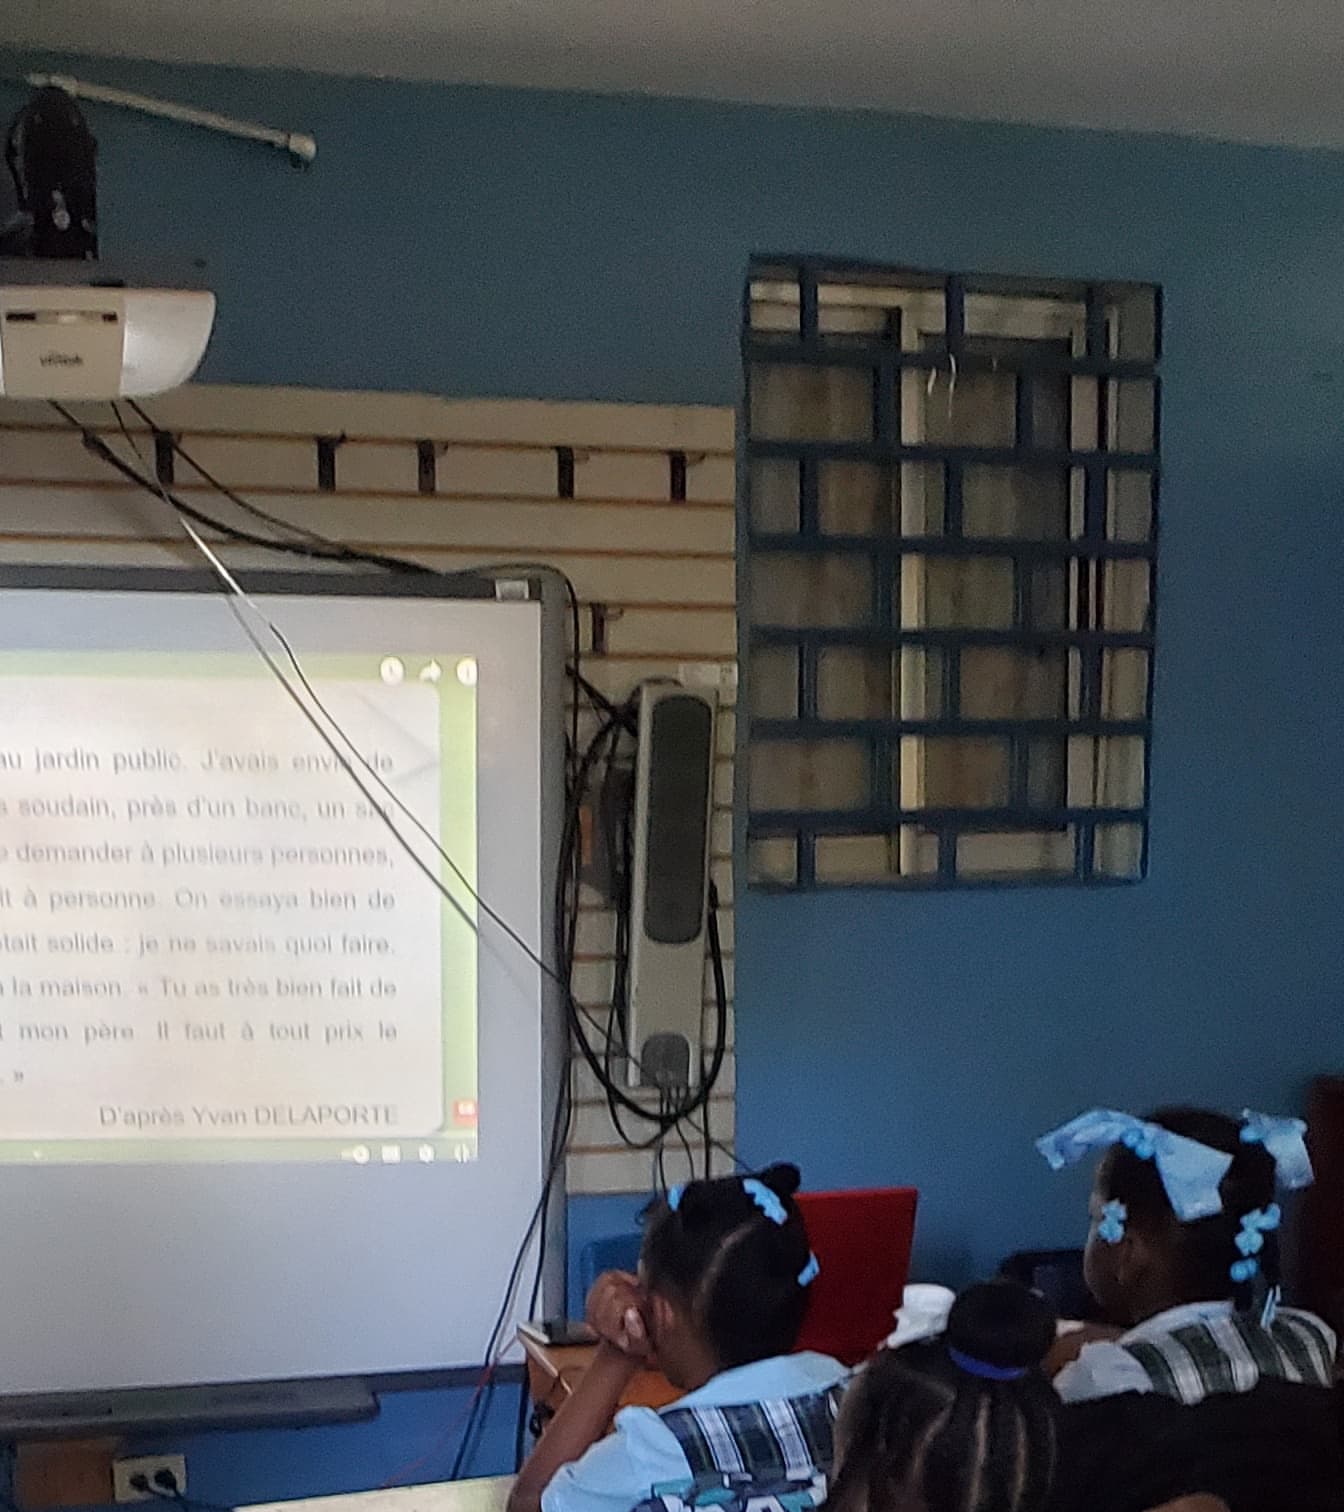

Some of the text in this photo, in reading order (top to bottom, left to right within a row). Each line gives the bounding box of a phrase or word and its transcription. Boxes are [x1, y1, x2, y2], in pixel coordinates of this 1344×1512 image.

[35, 747, 100, 775] jardin
[200, 748, 280, 770] J'avais
[18, 795, 117, 821] soudain,
[127, 796, 177, 823] près
[187, 795, 236, 818] d'un
[317, 801, 345, 818] un
[15, 841, 133, 864] demander
[140, 841, 155, 864] à
[162, 842, 263, 868] plusieurs
[24, 887, 38, 907] à
[175, 888, 207, 908] On
[218, 891, 298, 914] essaya
[309, 887, 357, 909] bien
[367, 887, 396, 909] de
[47, 932, 114, 953] solide
[139, 933, 158, 958] je
[170, 936, 197, 954] ne
[206, 934, 276, 954] savais
[285, 933, 332, 959] quoi
[12, 977, 32, 998] la
[160, 977, 187, 998] Tu
[194, 982, 221, 999] as
[228, 978, 269, 999] très
[276, 978, 323, 1000] bien
[330, 977, 362, 1000] fait
[370, 978, 398, 1000] de
[18, 1024, 69, 1041] mon
[156, 1019, 170, 1041] Il
[184, 1020, 226, 1042] faut
[240, 1020, 254, 1042] à
[269, 1021, 309, 1042] tout
[324, 1021, 364, 1048] prix
[378, 1021, 398, 1042] le
[98, 1105, 399, 1131] D'après Yvan DELAPORTE
